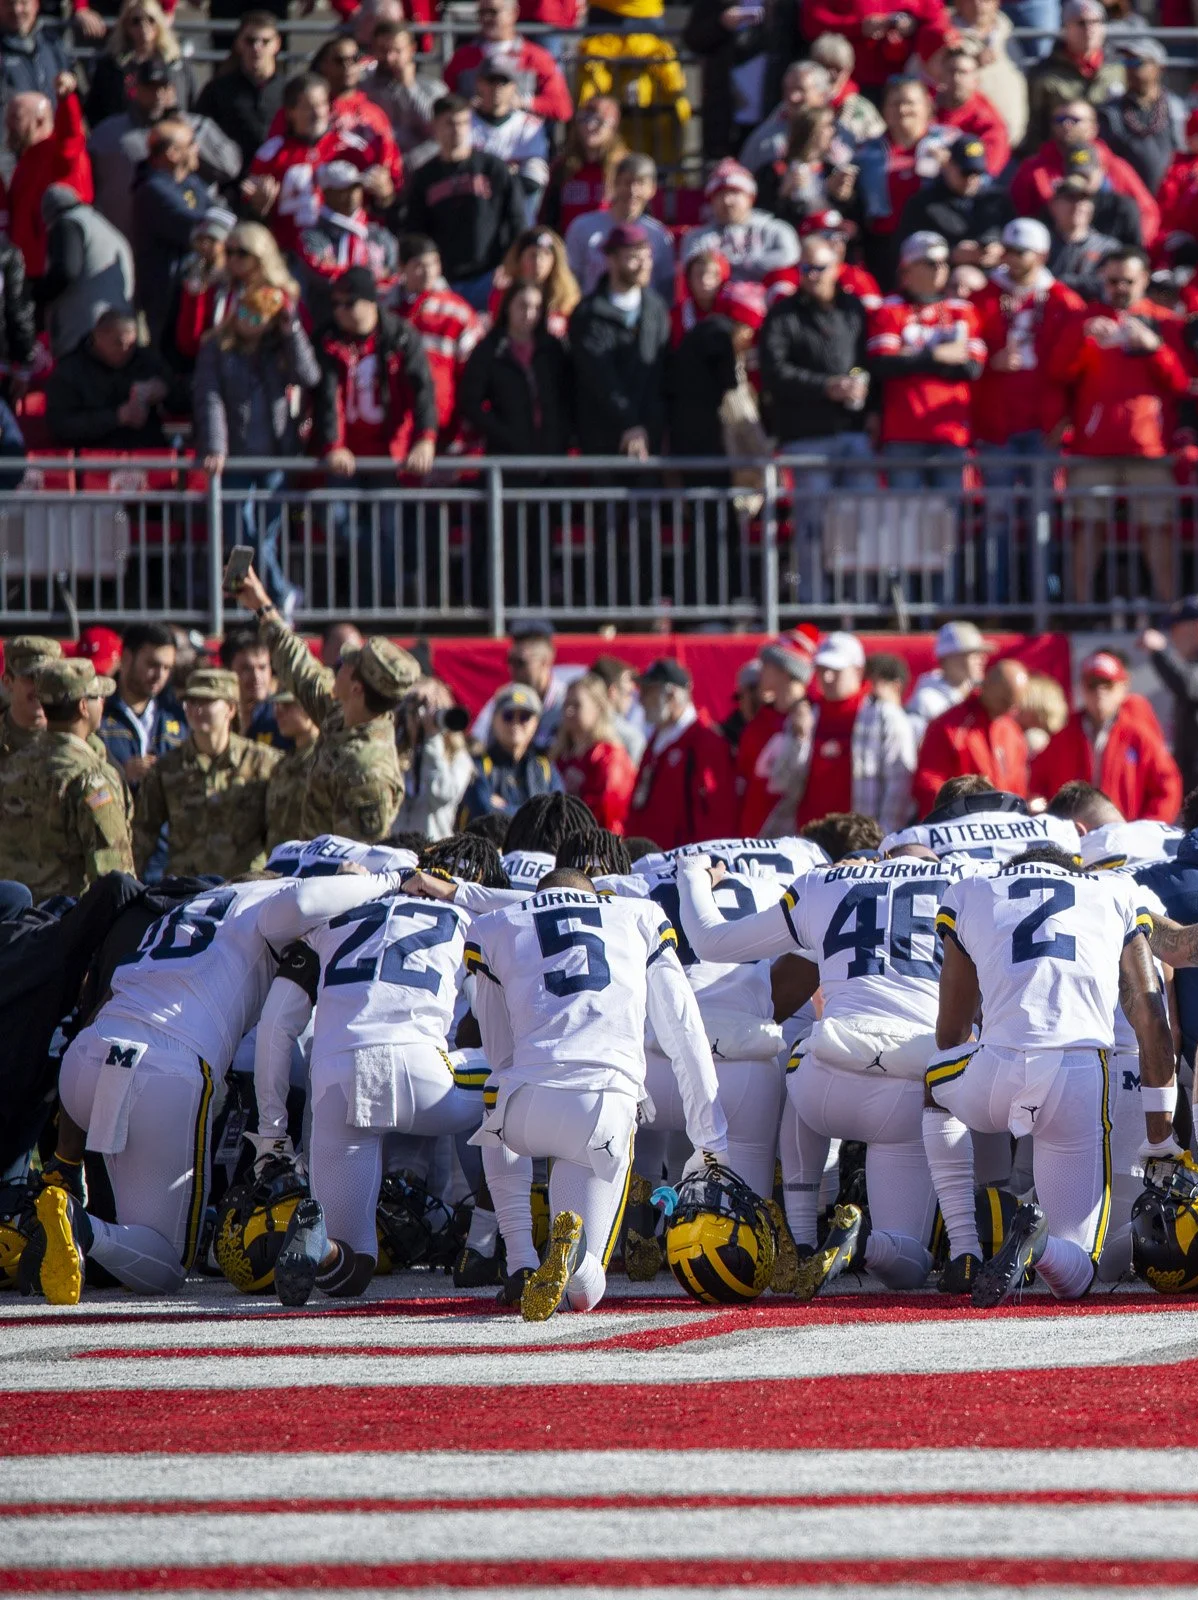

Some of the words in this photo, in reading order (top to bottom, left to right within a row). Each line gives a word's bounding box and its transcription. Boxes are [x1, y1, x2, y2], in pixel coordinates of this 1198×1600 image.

[928, 818, 1050, 849] ATTEBERRY
[502, 857, 552, 880] AIGE
[988, 864, 1099, 881] JOHNSON
[519, 892, 612, 911] TURNER
[1008, 877, 1076, 964] 2
[323, 901, 460, 995] 22
[533, 907, 611, 997] 5
[106, 1045, 136, 1068] M
